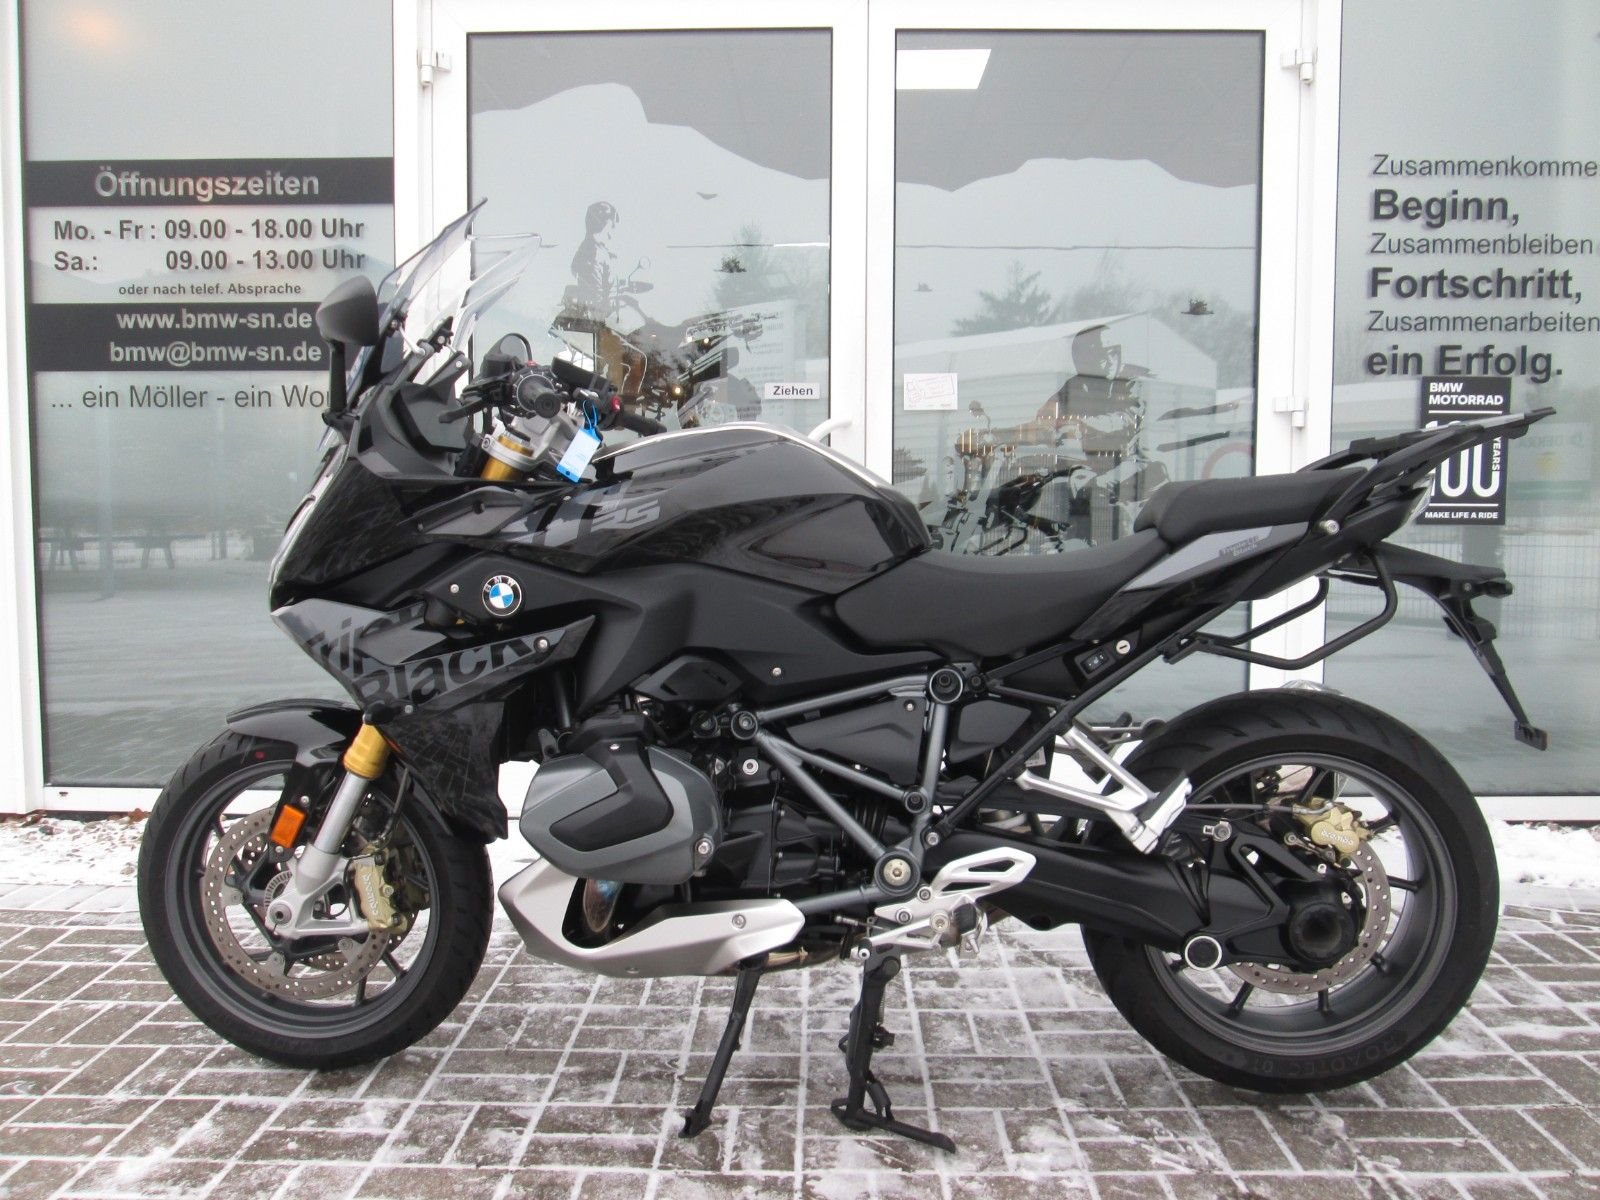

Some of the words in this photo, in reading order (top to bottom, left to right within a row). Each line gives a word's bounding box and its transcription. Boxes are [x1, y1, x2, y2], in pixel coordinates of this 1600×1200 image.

[1372, 154, 1600, 177] Zusammenkomme
[96, 166, 319, 202] Öffnungszeiten
[1373, 188, 1519, 228] Beginn,
[53, 221, 95, 240] Mo.
[165, 219, 226, 239] 09.00
[251, 219, 312, 238] 18.00
[321, 219, 364, 238] Uhr
[1371, 233, 1593, 254] Zusammenbleiben
[53, 252, 98, 271] Sa.:
[166, 251, 227, 270] 09.00
[252, 250, 313, 269] 13.00
[322, 249, 365, 268] Uhr
[118, 284, 149, 296] oder
[154, 284, 186, 295] nach
[191, 283, 224, 295] telef.
[228, 283, 301, 296] Absprache
[1371, 267, 1582, 304] Fortschritt,
[117, 309, 312, 329] www.bmw-sn.de
[1368, 311, 1600, 331] Zusammenarbeiten
[110, 341, 322, 366] bmw@bmw-sn.de
[1367, 345, 1423, 375] ein
[1439, 345, 1562, 383] Erfolg.
[83, 386, 118, 407] ein
[130, 386, 208, 407] Möller
[235, 386, 272, 406] ein
[772, 386, 812, 396] Ziehen
[1430, 383, 1463, 392] BMW
[1429, 395, 1503, 405] MOTORRAD
[484, 576, 516, 593] BMW
